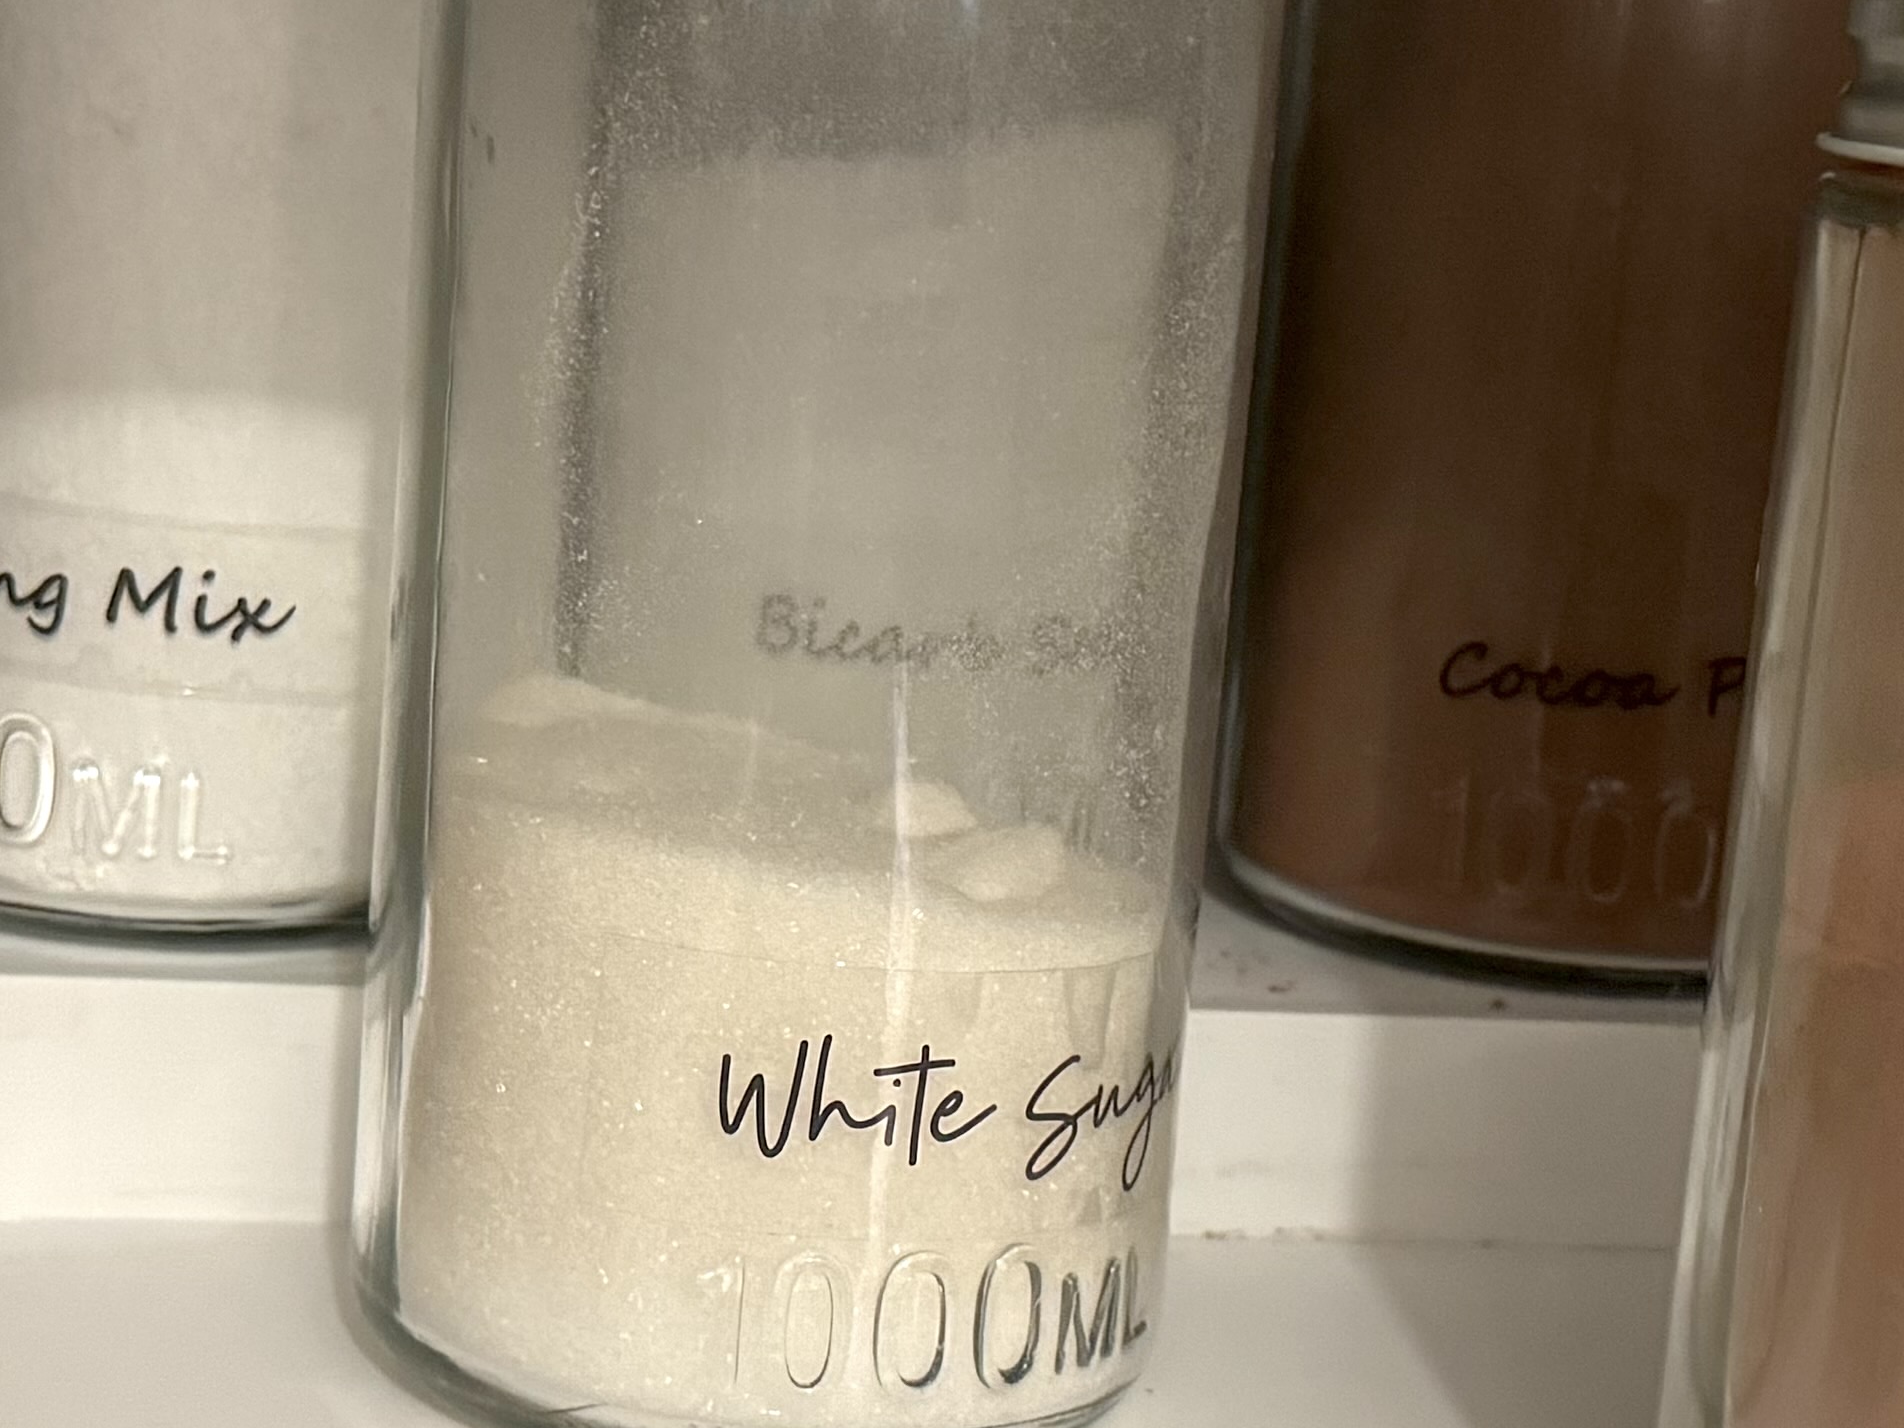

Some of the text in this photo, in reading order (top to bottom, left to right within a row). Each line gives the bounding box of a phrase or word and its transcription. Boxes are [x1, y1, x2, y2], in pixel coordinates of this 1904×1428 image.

[104, 567, 297, 645] Mix
[1439, 640, 1682, 711] Cocoa
[718, 1034, 998, 1167] White
[699, 1242, 1147, 1391] 1000ML
